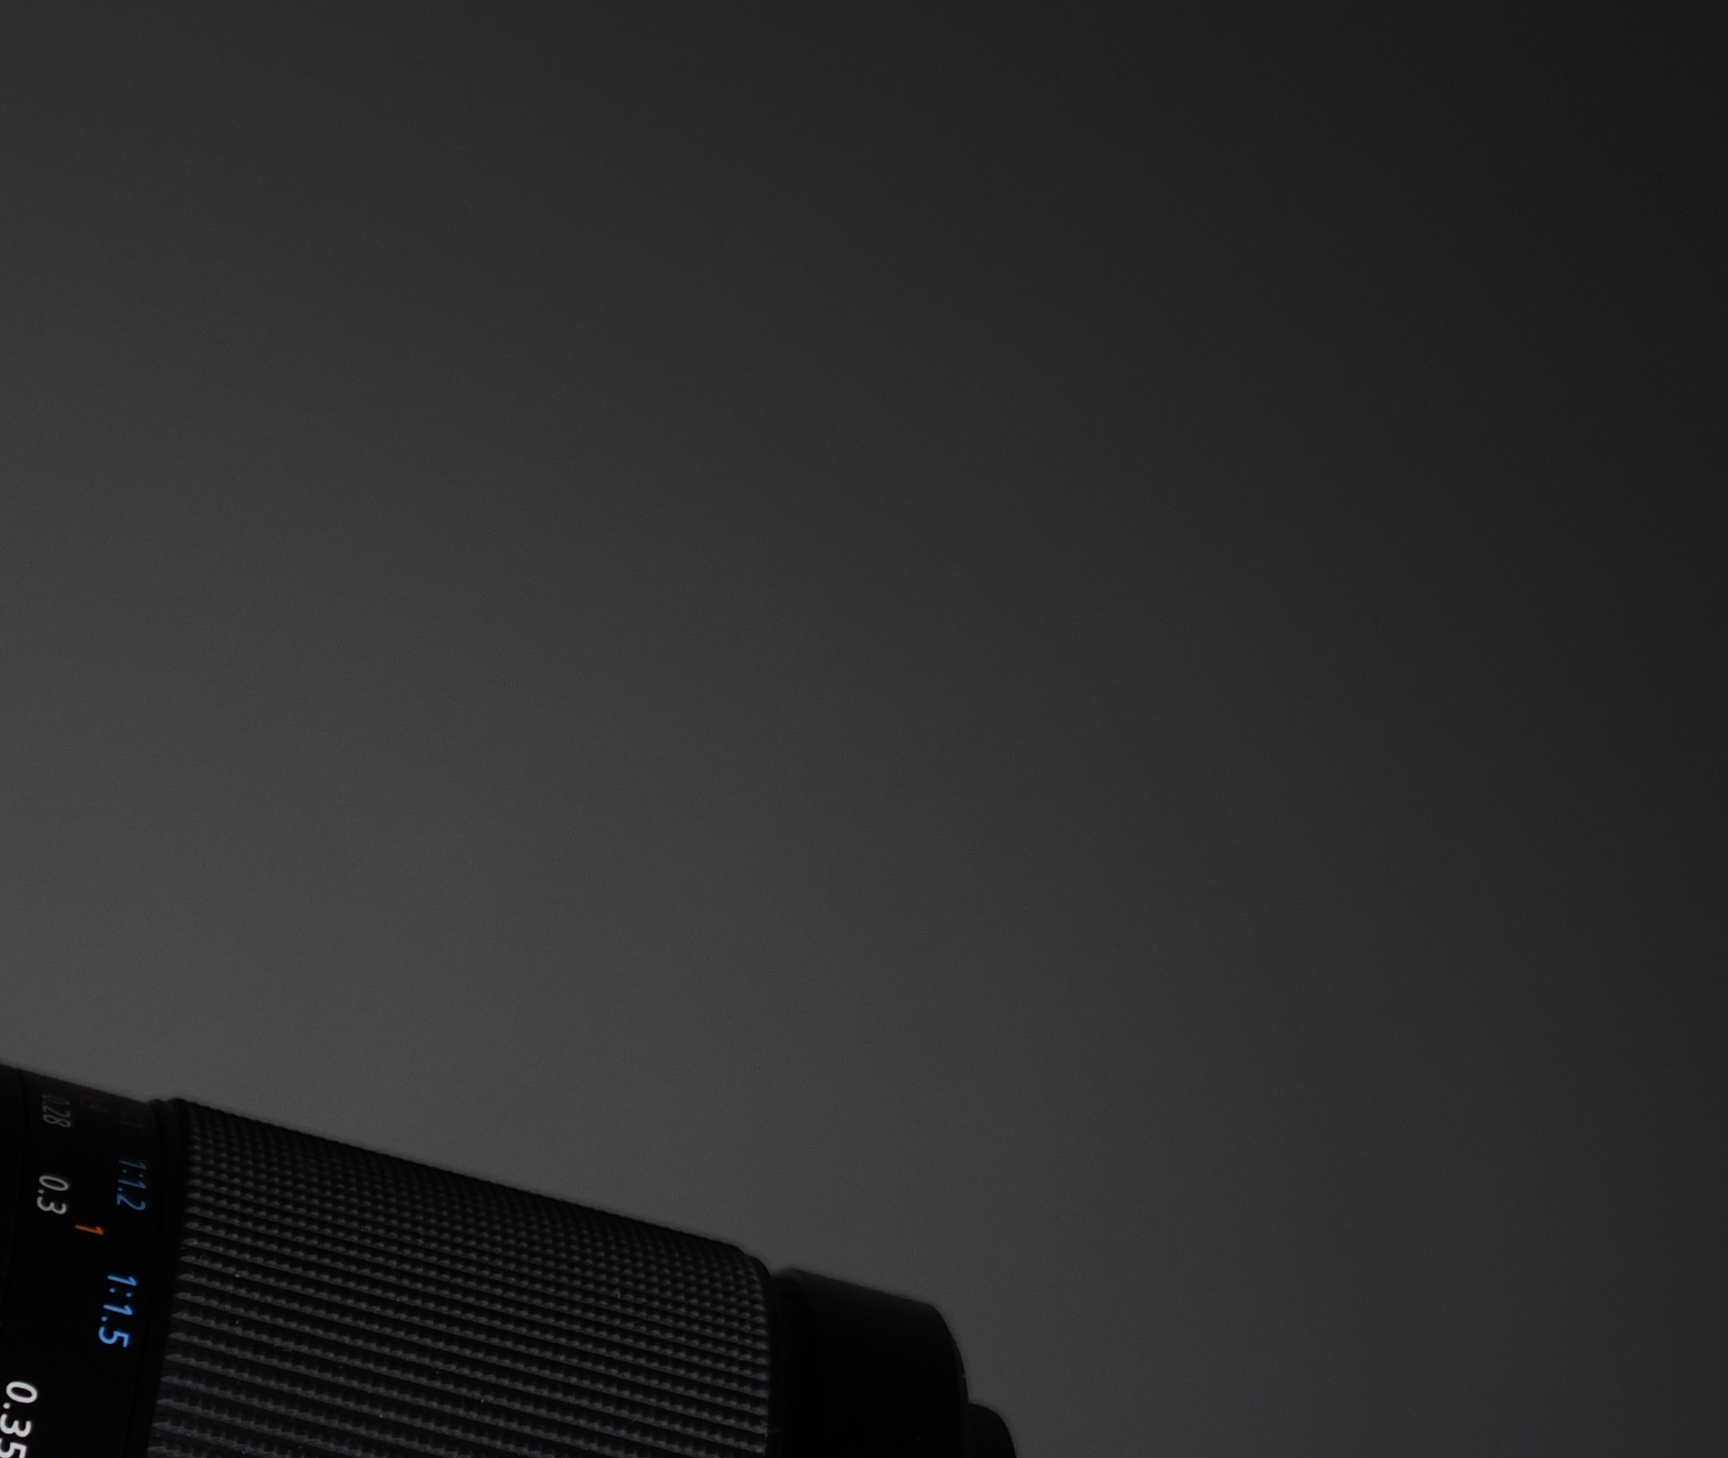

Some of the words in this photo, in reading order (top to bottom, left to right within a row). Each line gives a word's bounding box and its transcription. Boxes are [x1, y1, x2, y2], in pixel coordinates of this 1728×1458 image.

[36, 1175, 70, 1215] 0.3
[116, 1160, 147, 1211] 1:1.2
[75, 1224, 105, 1236] 1
[96, 1271, 141, 1350] 1:1.5
